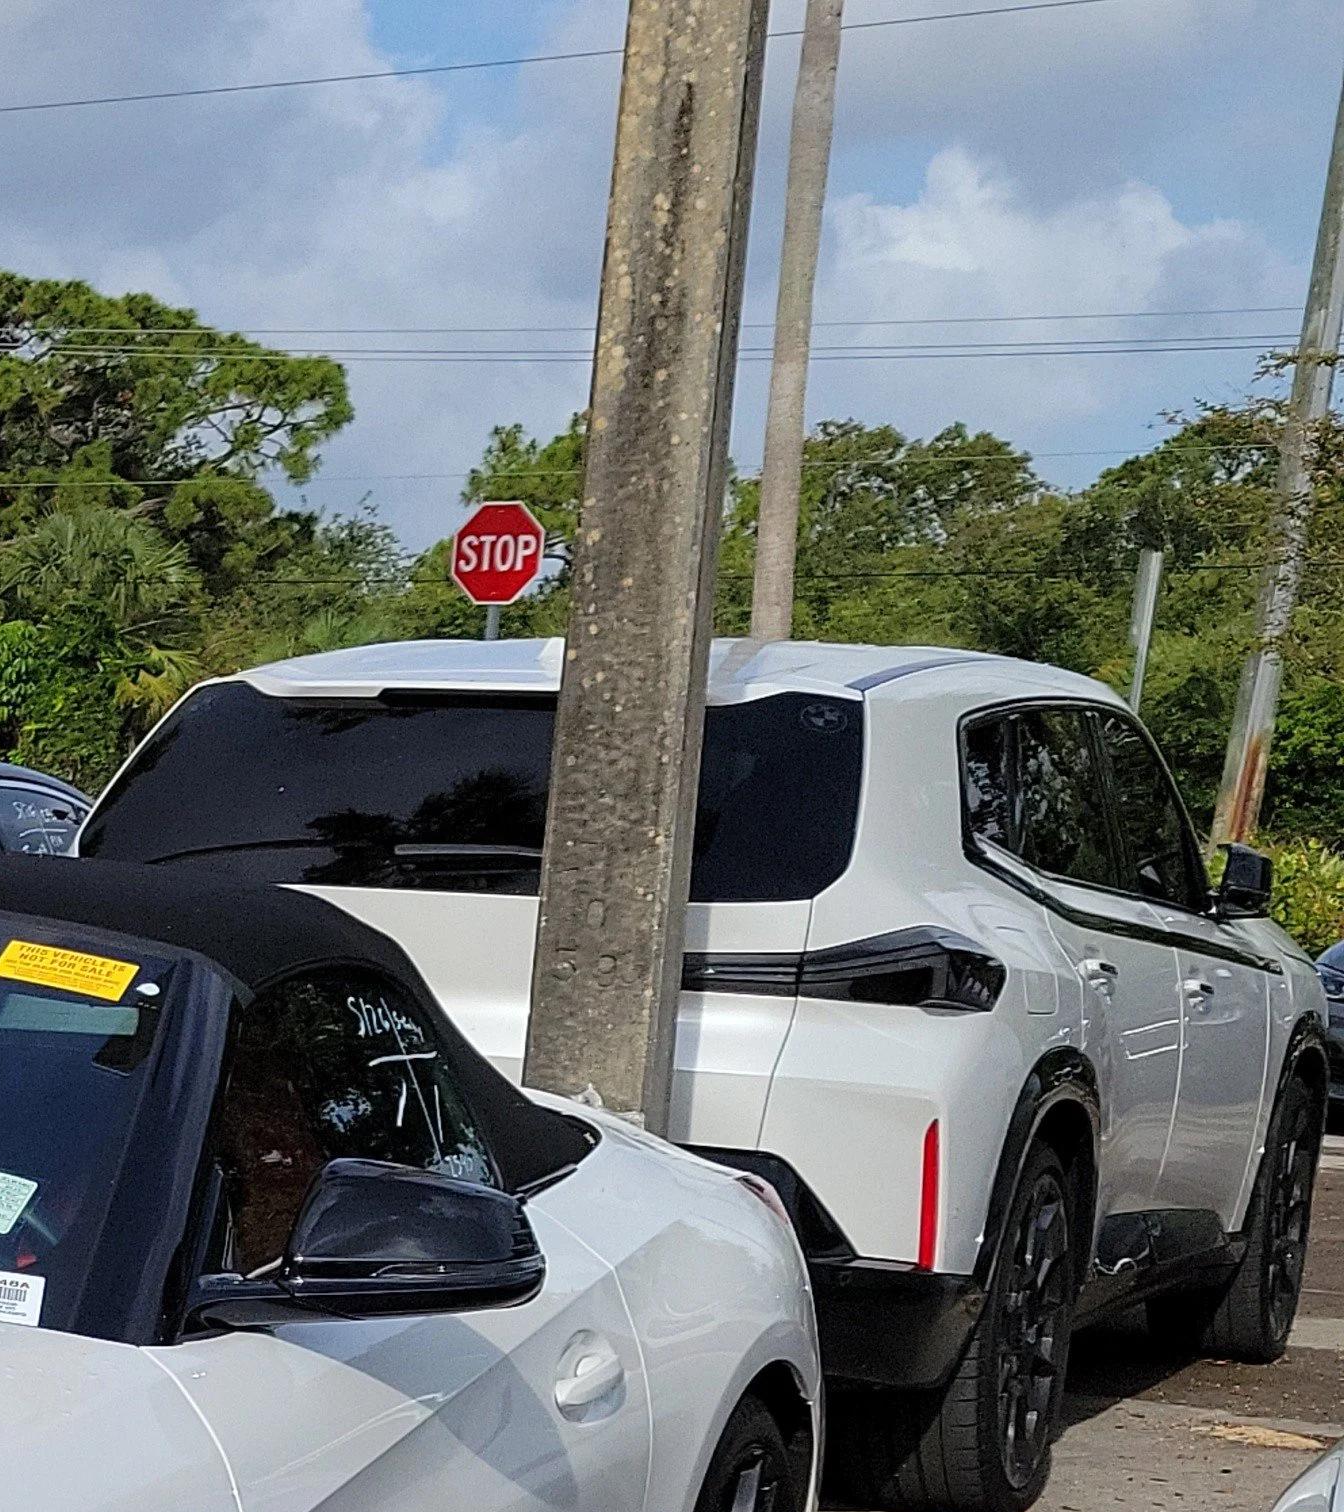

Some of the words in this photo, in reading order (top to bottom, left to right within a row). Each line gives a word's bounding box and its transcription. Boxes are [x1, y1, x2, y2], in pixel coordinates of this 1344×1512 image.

[458, 534, 537, 572] STOP
[19, 945, 48, 956] THIS
[53, 951, 109, 968] VEHICLE
[113, 964, 127, 972] IS
[19, 953, 49, 963] NOT
[51, 958, 76, 969] FOR
[80, 965, 113, 977] SALE
